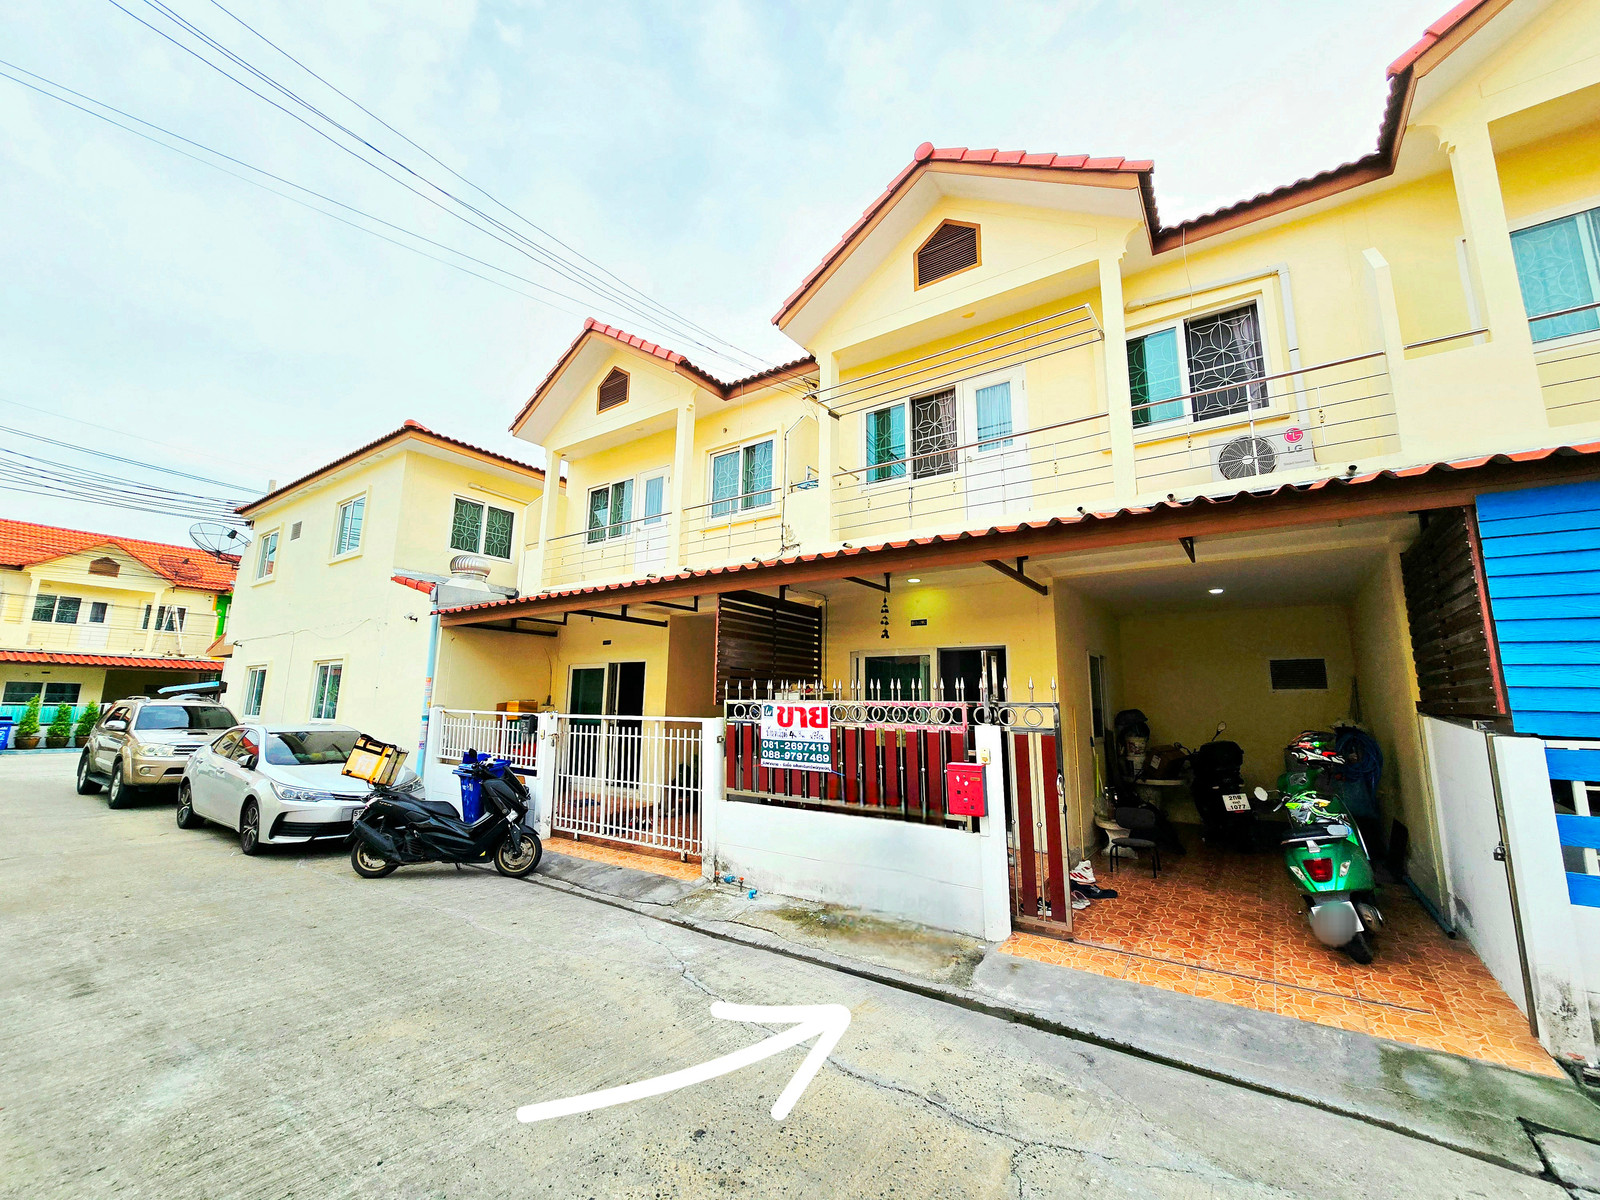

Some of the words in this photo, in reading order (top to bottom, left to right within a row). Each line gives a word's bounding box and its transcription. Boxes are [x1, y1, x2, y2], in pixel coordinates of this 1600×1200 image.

[776, 706, 829, 729] ขาย
[762, 740, 829, 752] 081-2697419
[762, 749, 830, 763] 088-9797469
